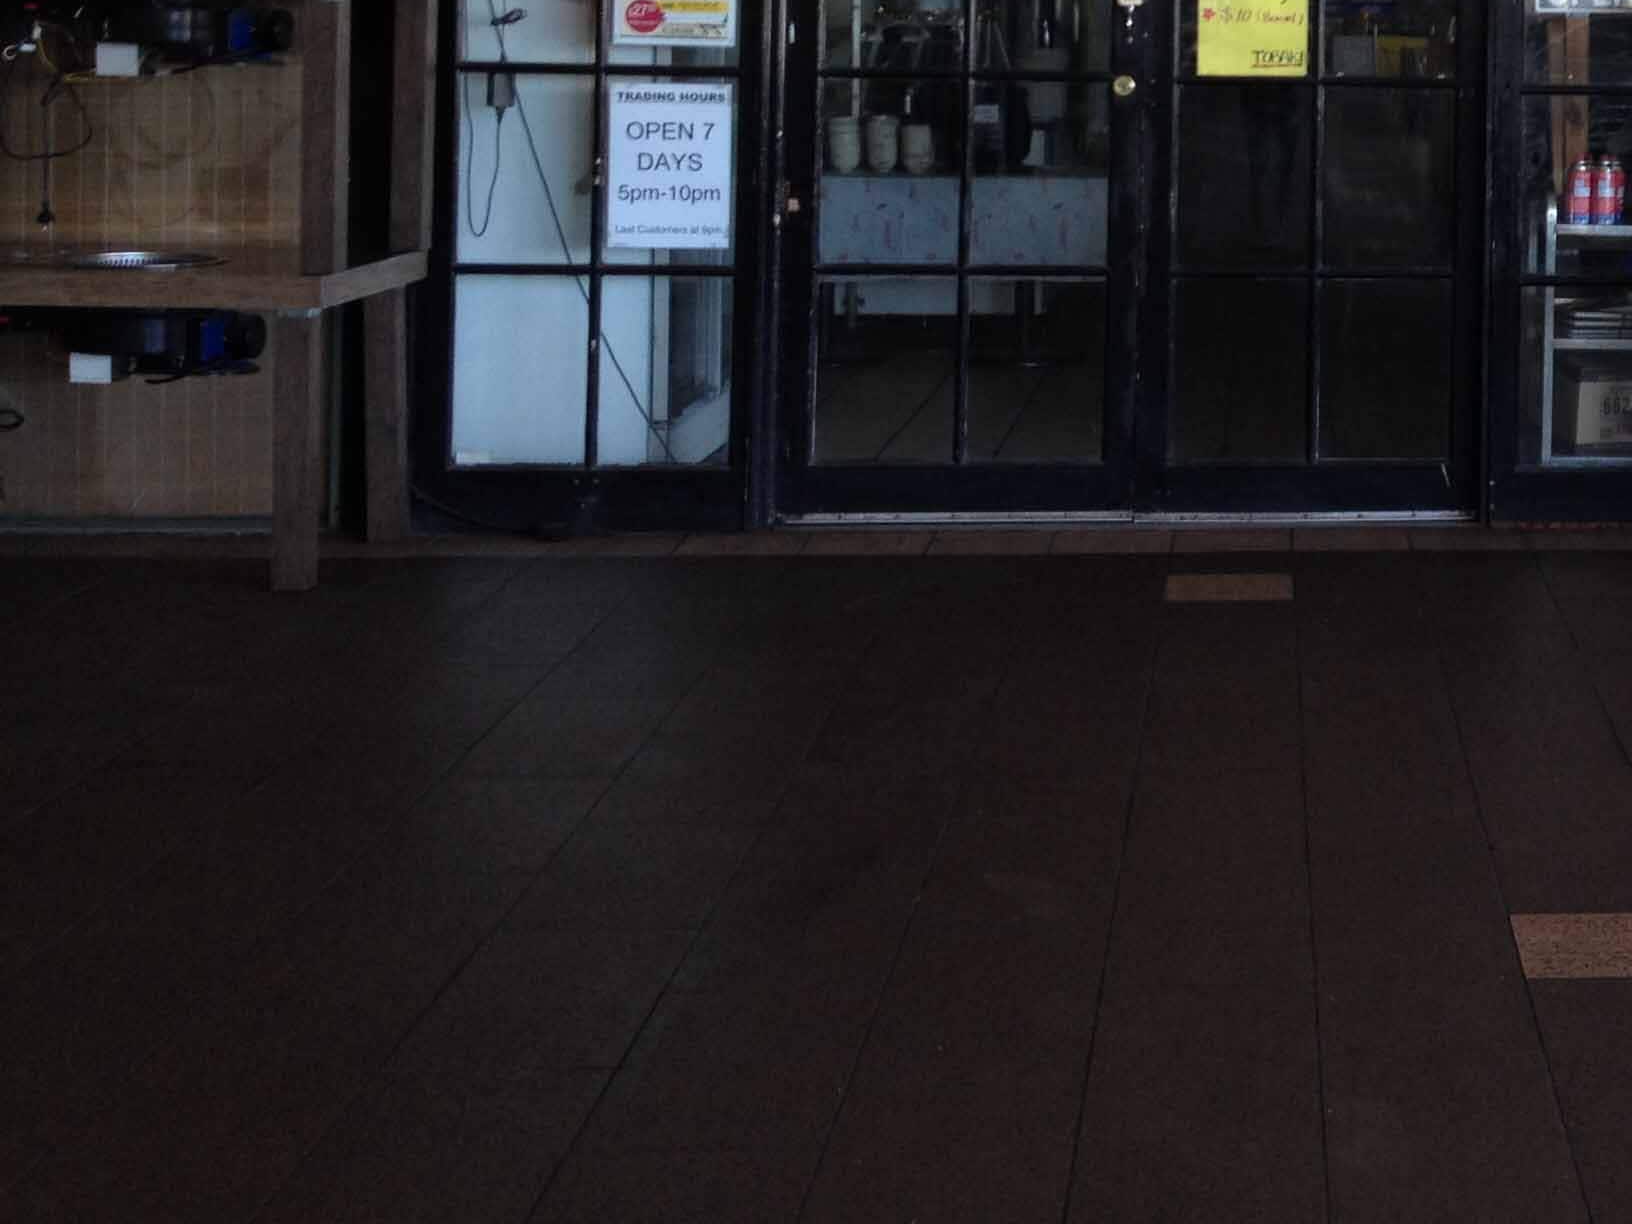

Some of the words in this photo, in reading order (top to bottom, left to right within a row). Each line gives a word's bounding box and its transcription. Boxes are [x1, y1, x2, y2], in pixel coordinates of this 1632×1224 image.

[617, 91, 676, 103] TRADING
[679, 92, 726, 103] HOURS
[626, 121, 695, 141] OPEN
[703, 123, 716, 141] 7
[637, 152, 703, 172] DAYS
[617, 184, 722, 205] 5pm-10pm
